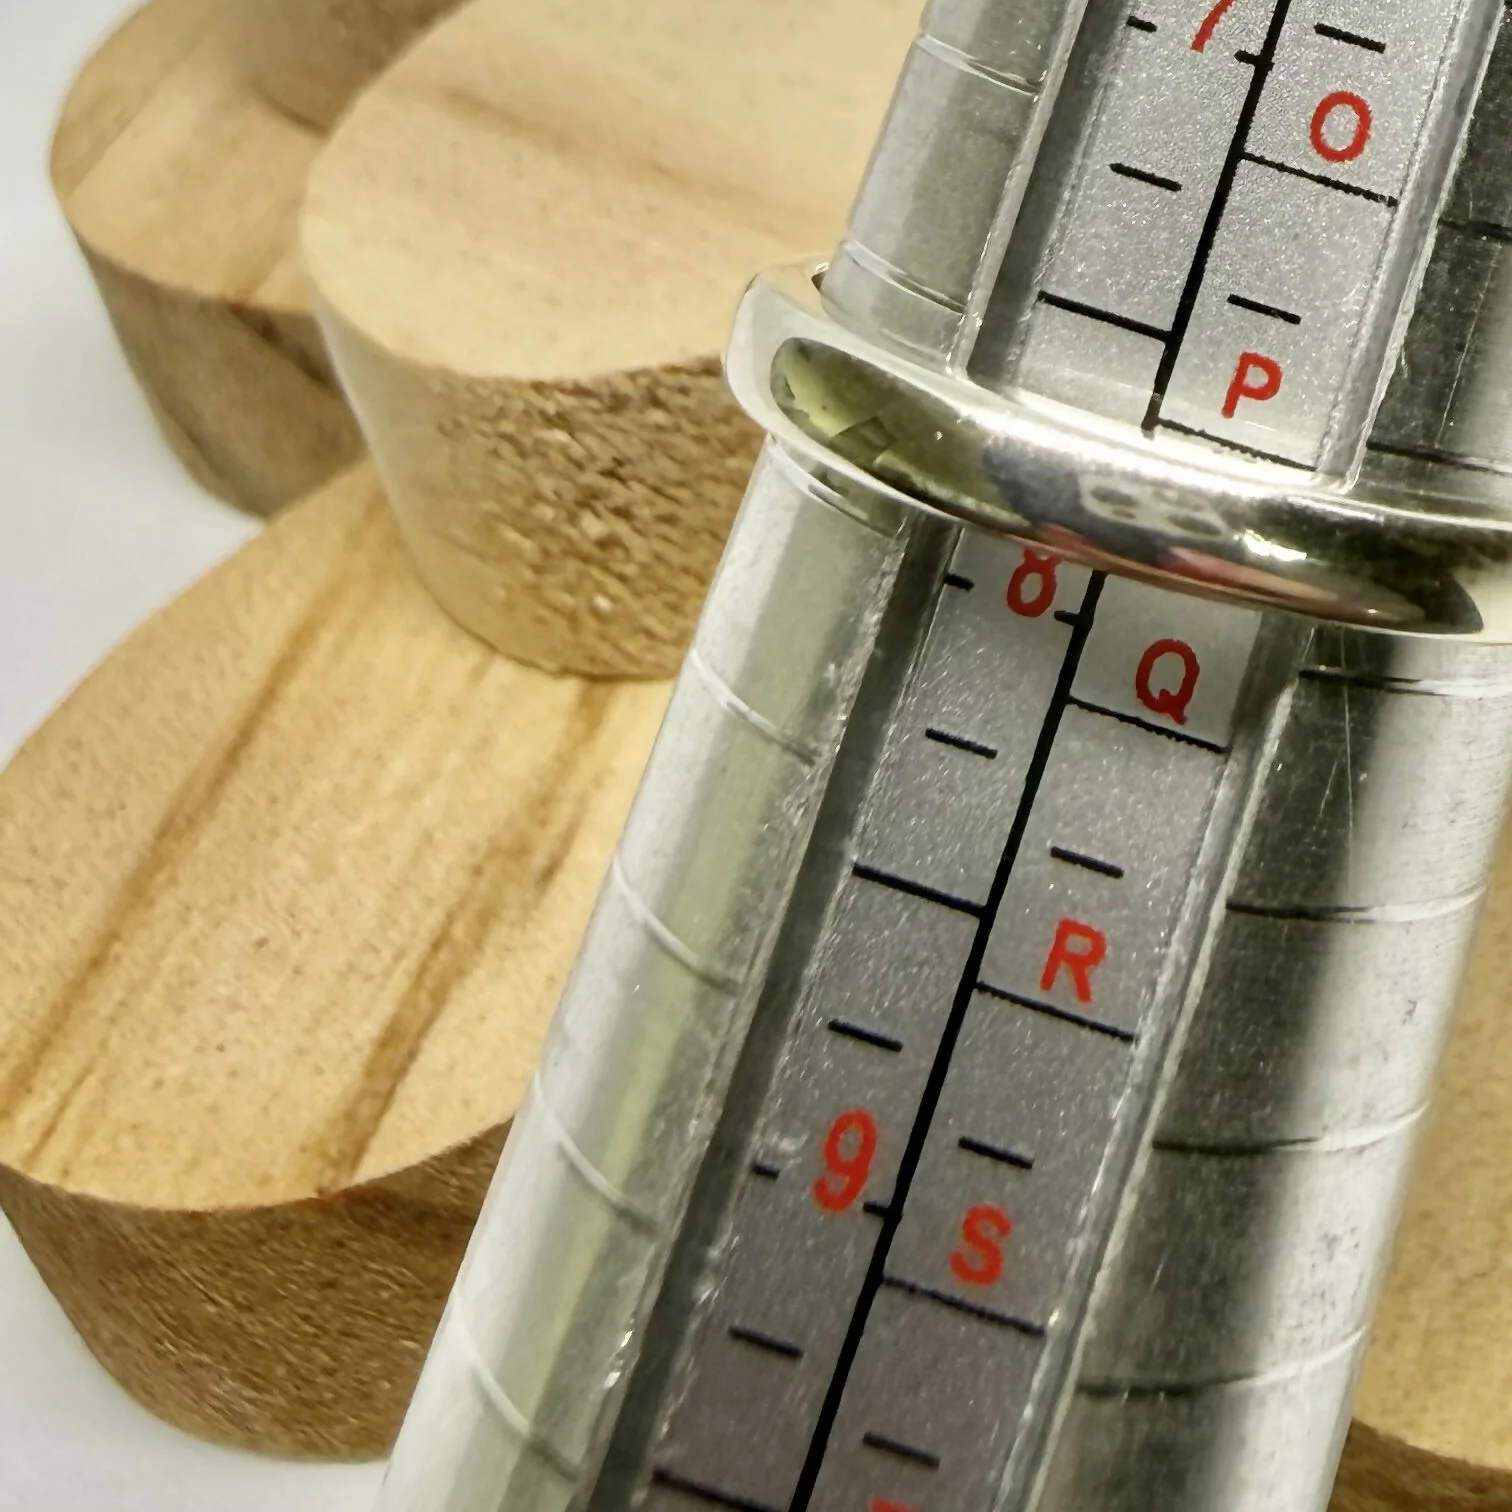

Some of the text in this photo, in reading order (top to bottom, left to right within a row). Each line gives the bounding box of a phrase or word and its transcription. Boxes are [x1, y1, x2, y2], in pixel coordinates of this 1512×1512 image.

[1309, 89, 1373, 165] O
[1222, 350, 1285, 419] P
[1134, 638, 1202, 725] Q
[1038, 914, 1108, 1008] R
[810, 1107, 880, 1215] 9
[947, 1203, 1015, 1290] S
